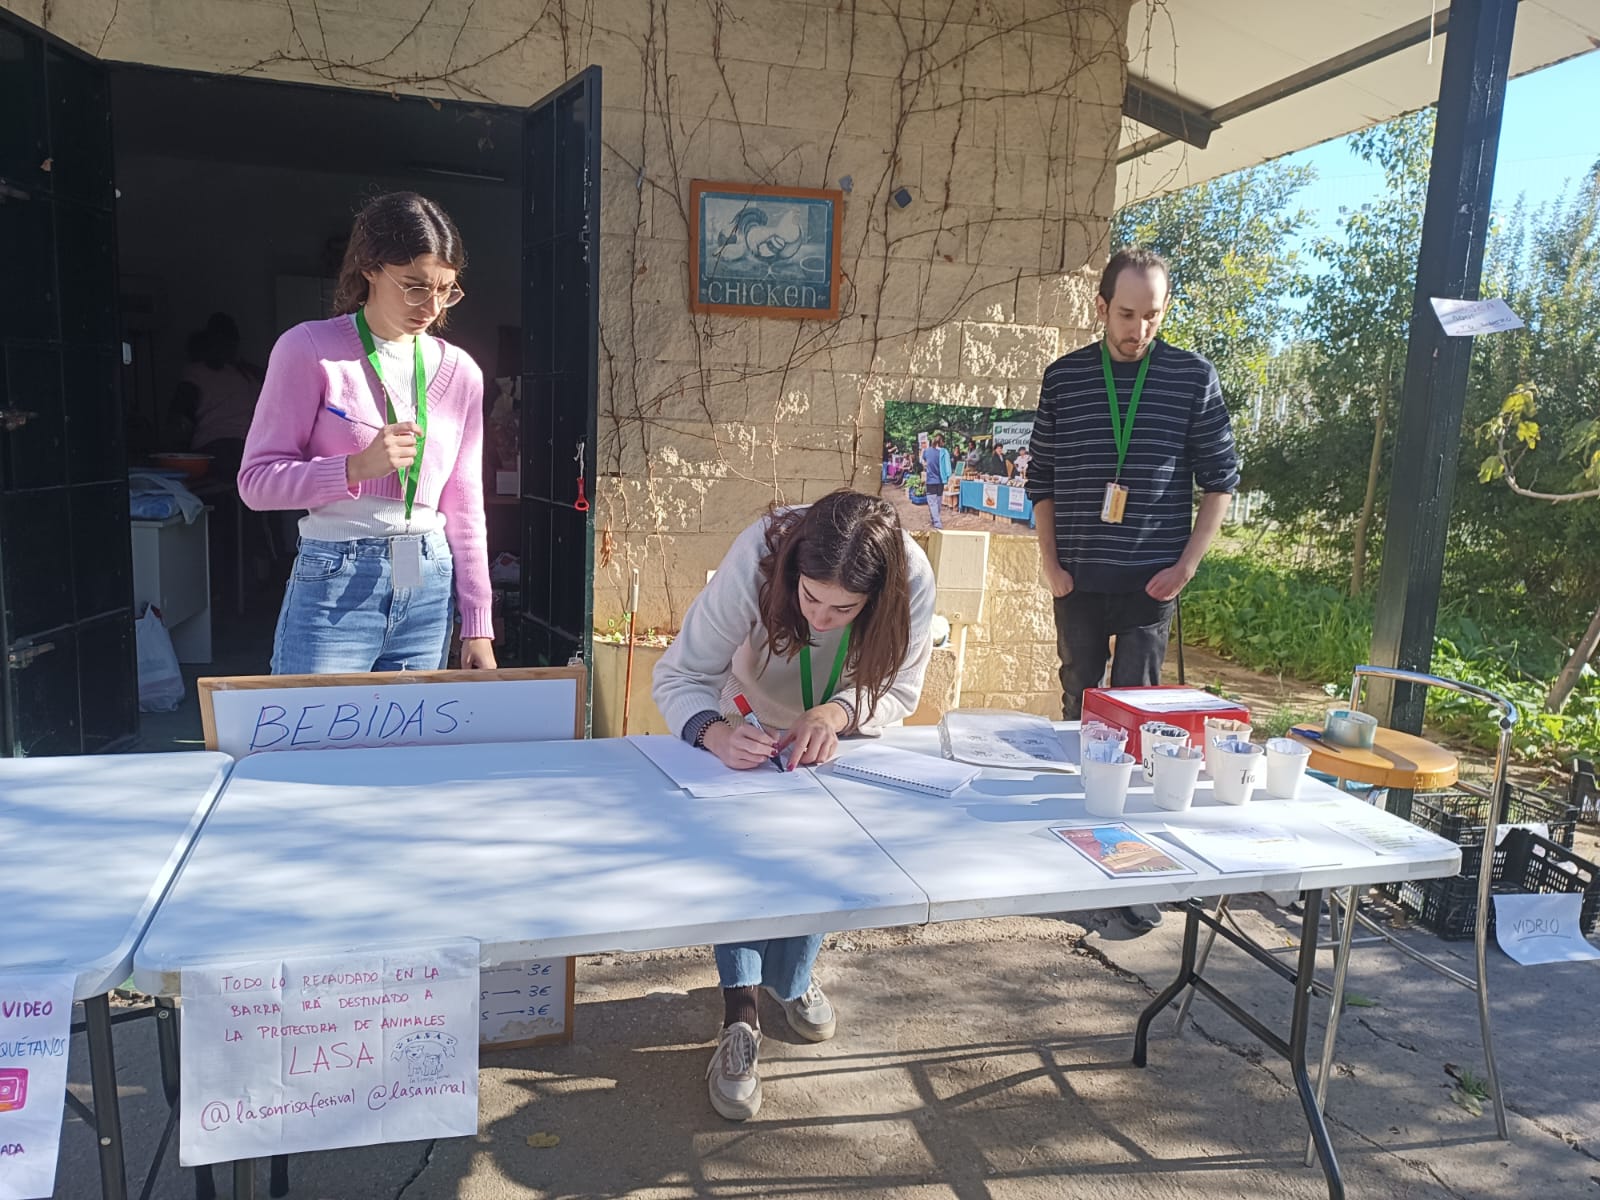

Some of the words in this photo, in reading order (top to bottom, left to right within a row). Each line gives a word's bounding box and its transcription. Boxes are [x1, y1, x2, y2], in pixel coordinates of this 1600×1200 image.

[1513, 918, 1560, 934] VIDRIO
[222, 976, 262, 990] TODO
[271, 977, 286, 989] LO
[303, 972, 378, 987] RECAUDADO
[395, 967, 414, 981] EN
[424, 966, 439, 979] LA
[2, 1001, 53, 1018] VIDEO
[231, 1003, 281, 1017] BARRA
[302, 997, 322, 1011] IRÁ
[339, 993, 409, 1008] DESTINADO
[424, 989, 433, 1000] A
[225, 1028, 243, 1042] LA
[257, 1023, 337, 1039] PROTECTORA
[354, 1019, 373, 1031] DE
[381, 1015, 445, 1030] ANIMALES
[288, 1042, 375, 1075] LASA
